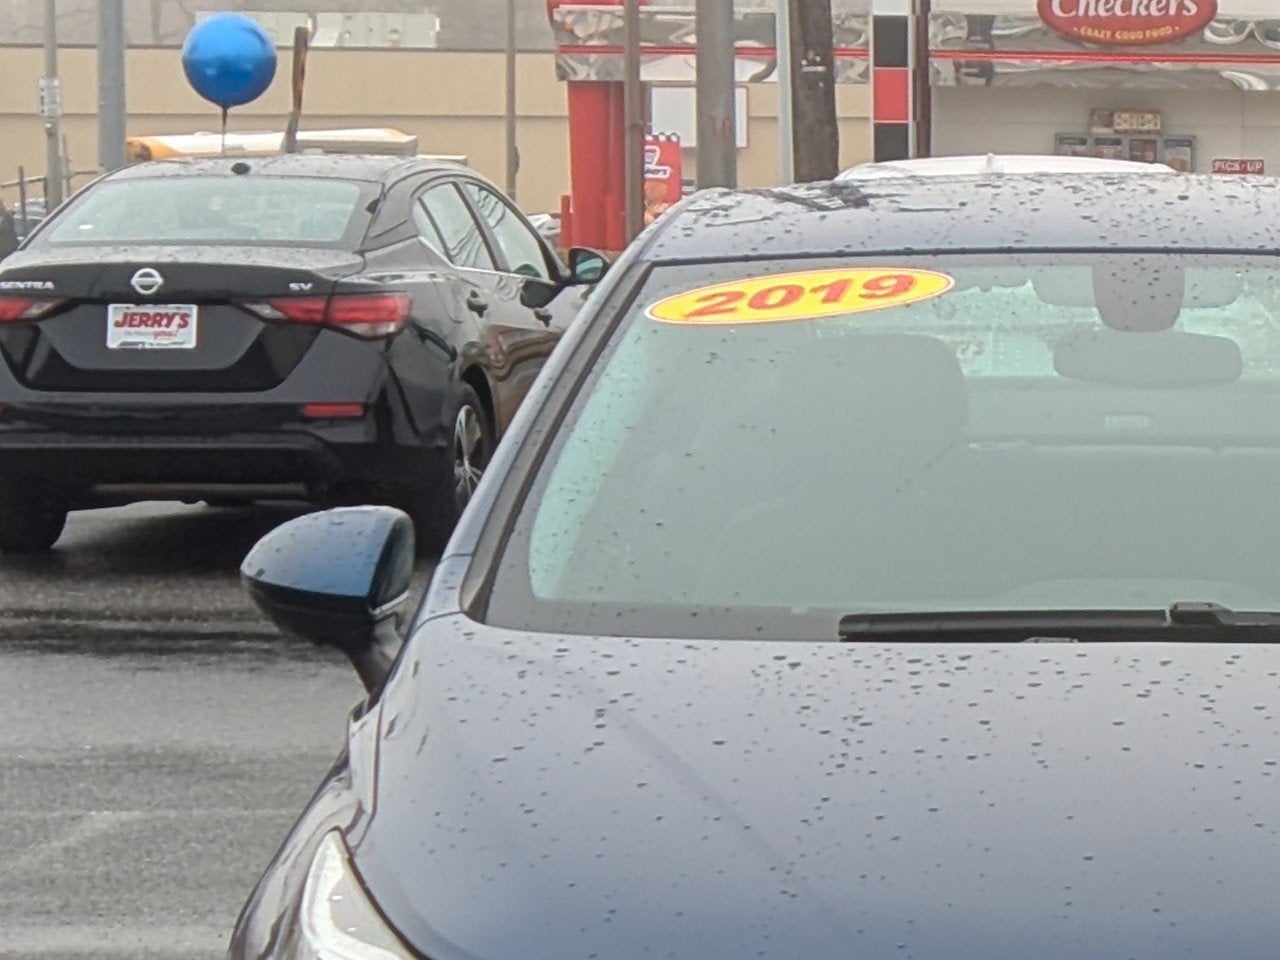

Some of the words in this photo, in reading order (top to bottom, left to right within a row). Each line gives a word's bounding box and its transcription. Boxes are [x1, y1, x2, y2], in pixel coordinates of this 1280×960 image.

[1052, 0, 1198, 17] Checkers
[1145, 25, 1173, 39] FOOD
[289, 282, 313, 291] SV
[683, 274, 915, 321] 2019
[114, 312, 191, 329] JERRY'S
